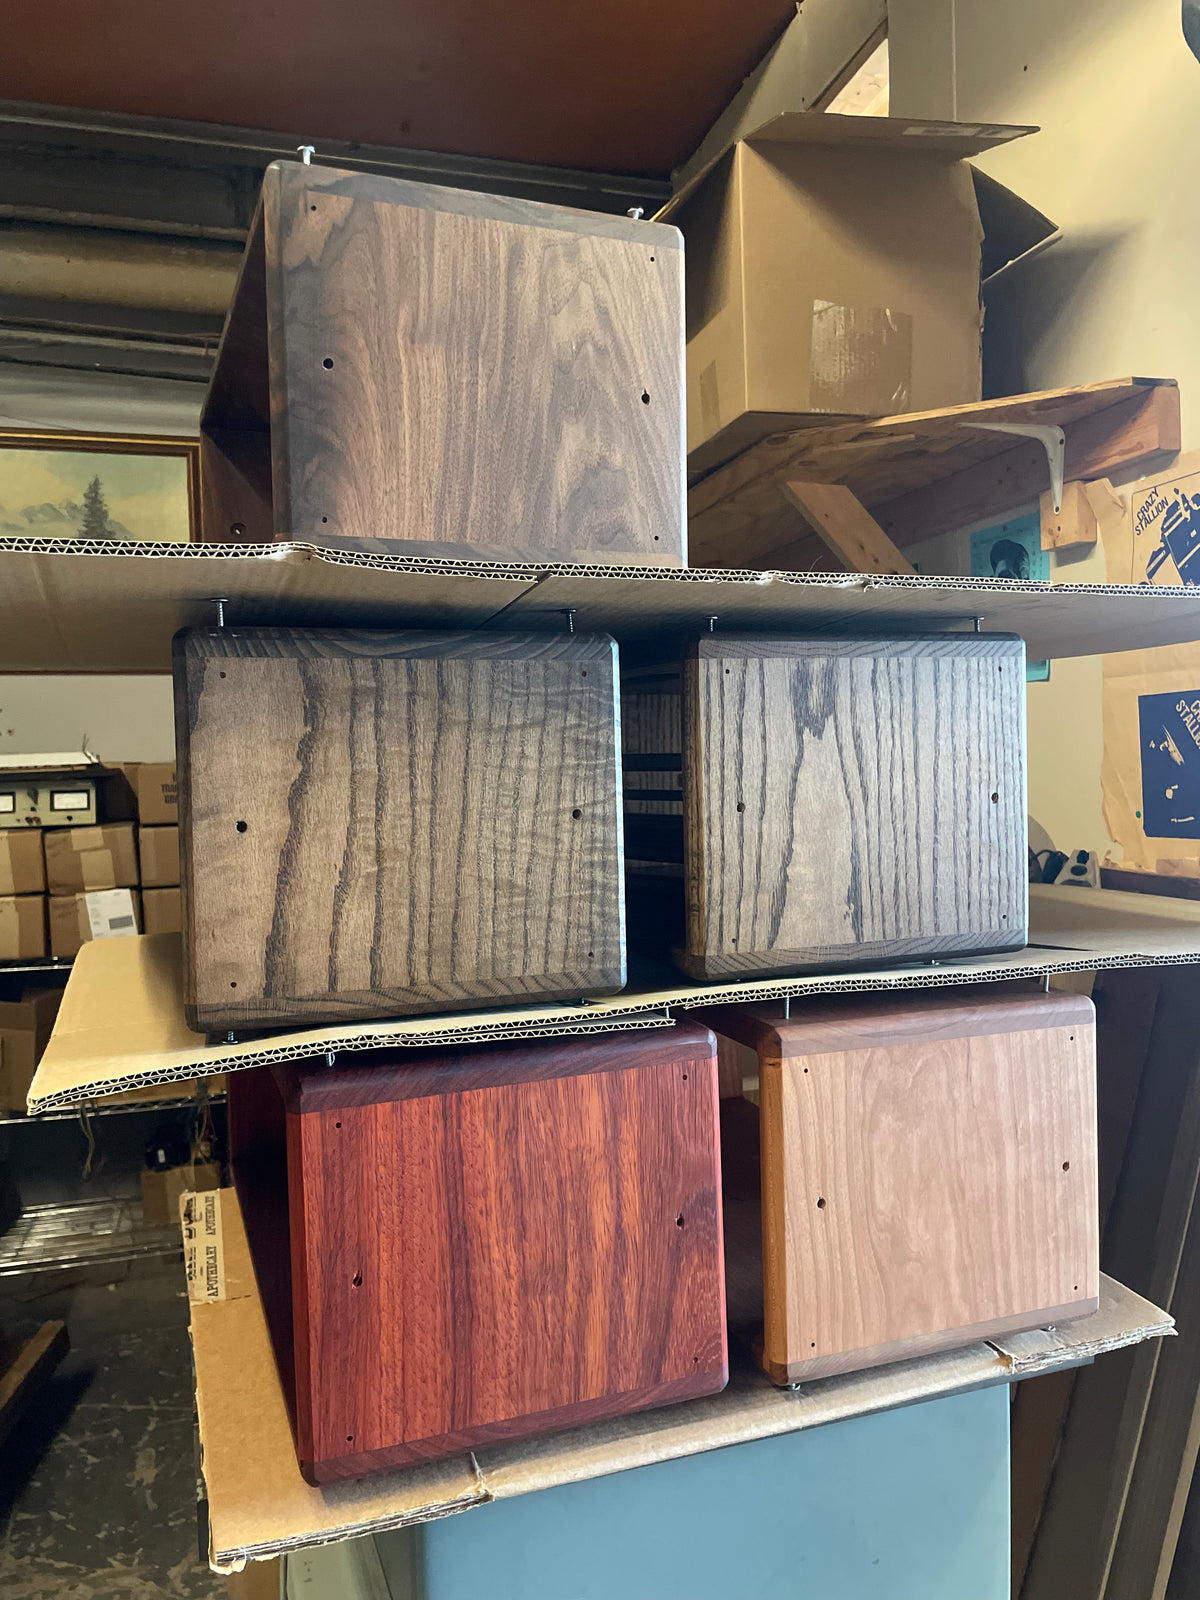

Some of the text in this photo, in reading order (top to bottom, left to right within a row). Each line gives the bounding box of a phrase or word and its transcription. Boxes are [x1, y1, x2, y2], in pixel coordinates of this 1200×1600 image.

[1135, 496, 1169, 536] STALLION
[1136, 486, 1160, 522] CRAZY
[206, 1246, 219, 1297] APOTHECARY
